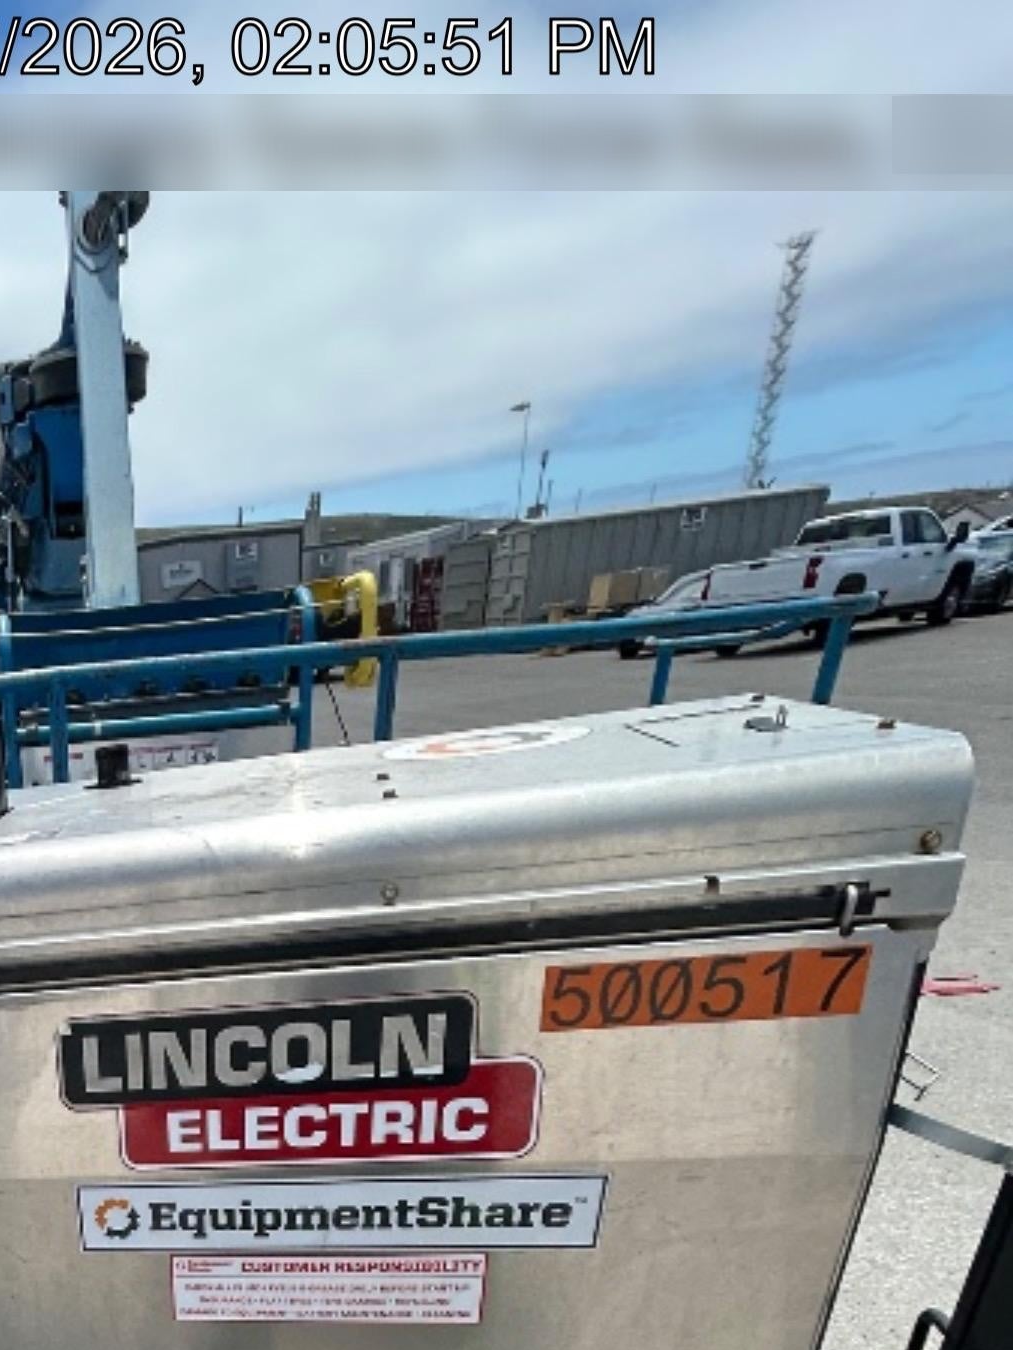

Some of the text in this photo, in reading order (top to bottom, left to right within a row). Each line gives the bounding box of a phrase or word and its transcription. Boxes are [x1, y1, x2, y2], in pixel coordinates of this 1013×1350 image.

[549, 946, 867, 1027] 500517
[81, 1012, 448, 1093] LINCOLN
[166, 1097, 490, 1153] ELECTRIC
[148, 1195, 573, 1239] EquipmentShare
[334, 1257, 484, 1274] RESPONSIBILITY
